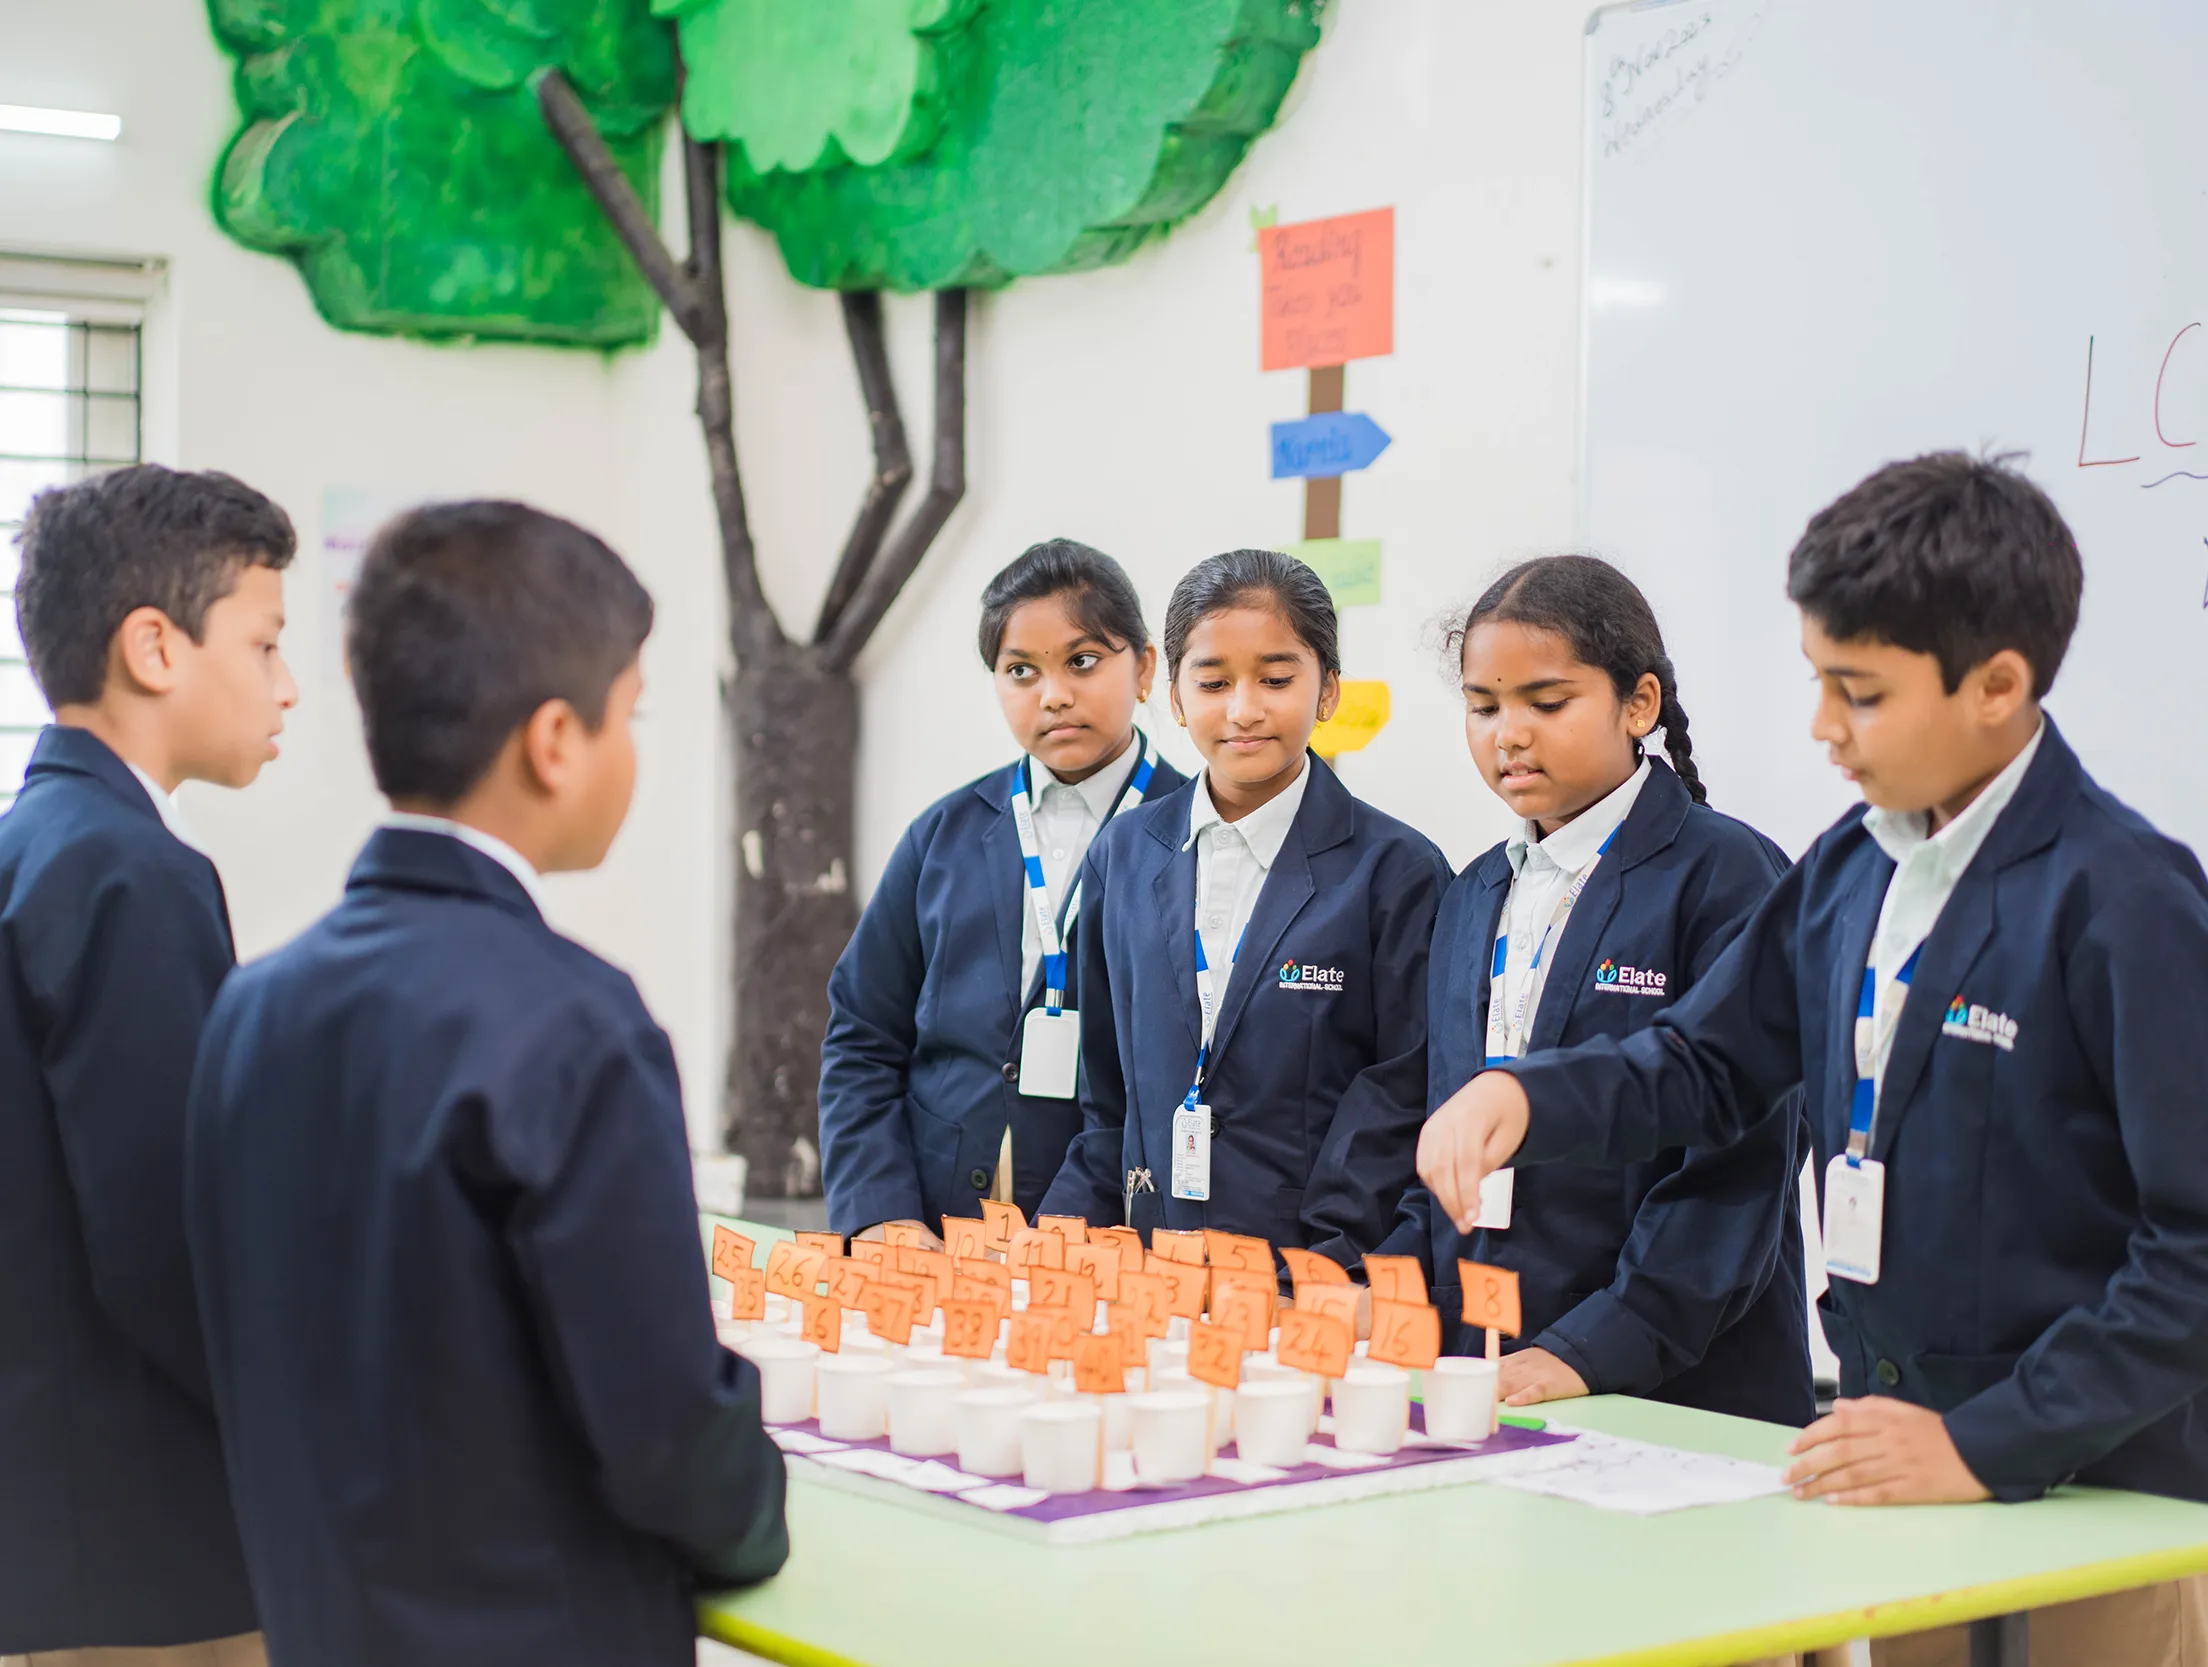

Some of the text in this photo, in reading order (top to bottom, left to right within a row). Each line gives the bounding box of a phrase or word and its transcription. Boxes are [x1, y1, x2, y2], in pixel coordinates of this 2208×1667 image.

[1568, 874, 1588, 898] Elate
[1302, 965, 1344, 982] Elate
[1619, 966, 1667, 987] Elate
[997, 1212, 1013, 1243] 1
[772, 1248, 814, 1288] 26
[1018, 1240, 1045, 1267] 11
[833, 1267, 868, 1304] 27
[1042, 1280, 1071, 1307] 21
[1381, 1266, 1399, 1301] 7
[1484, 1277, 1503, 1318] 8
[1284, 1321, 1331, 1366] 24
[1379, 1313, 1411, 1355] 16
